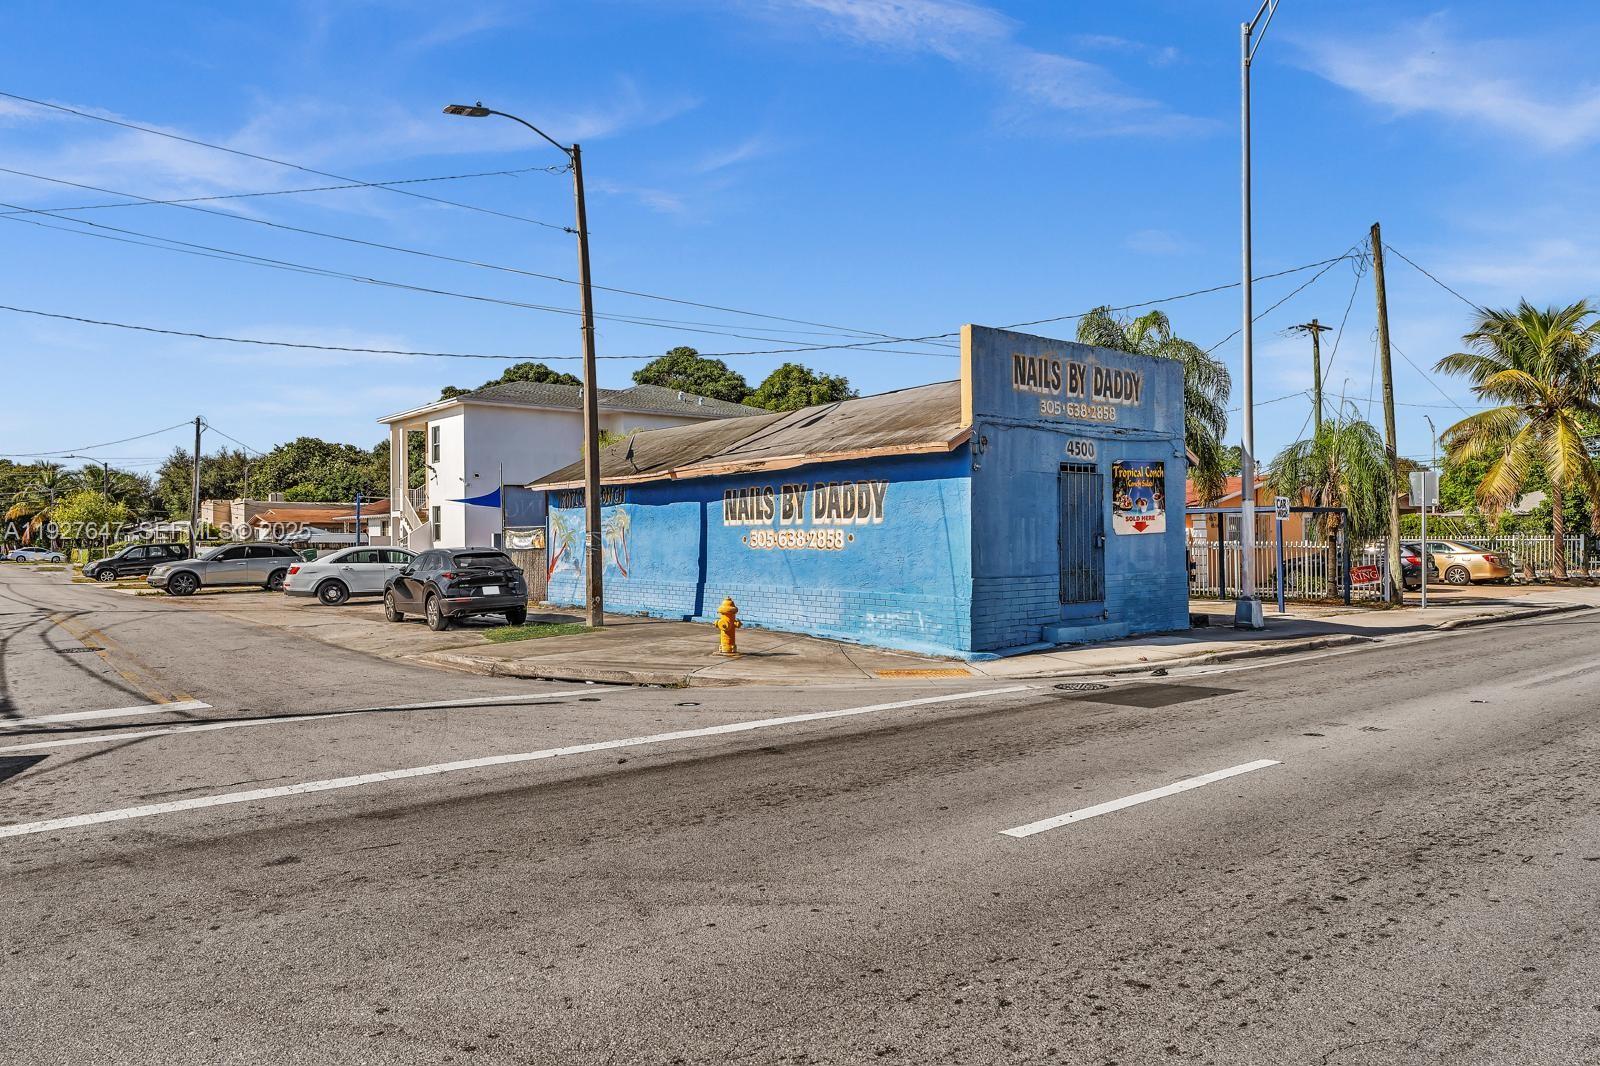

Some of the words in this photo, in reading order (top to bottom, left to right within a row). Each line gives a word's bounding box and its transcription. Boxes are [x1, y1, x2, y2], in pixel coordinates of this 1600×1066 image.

[1013, 355, 1061, 394] NAILS
[1067, 362, 1087, 398] BY
[1092, 366, 1141, 405] DADDY
[1066, 440, 1096, 458] 4500
[1113, 465, 1144, 479] Tropical
[724, 486, 775, 526] NAILS
[780, 483, 808, 525] BY
[812, 480, 889, 525] DADDY
[1351, 570, 1378, 581] KING
